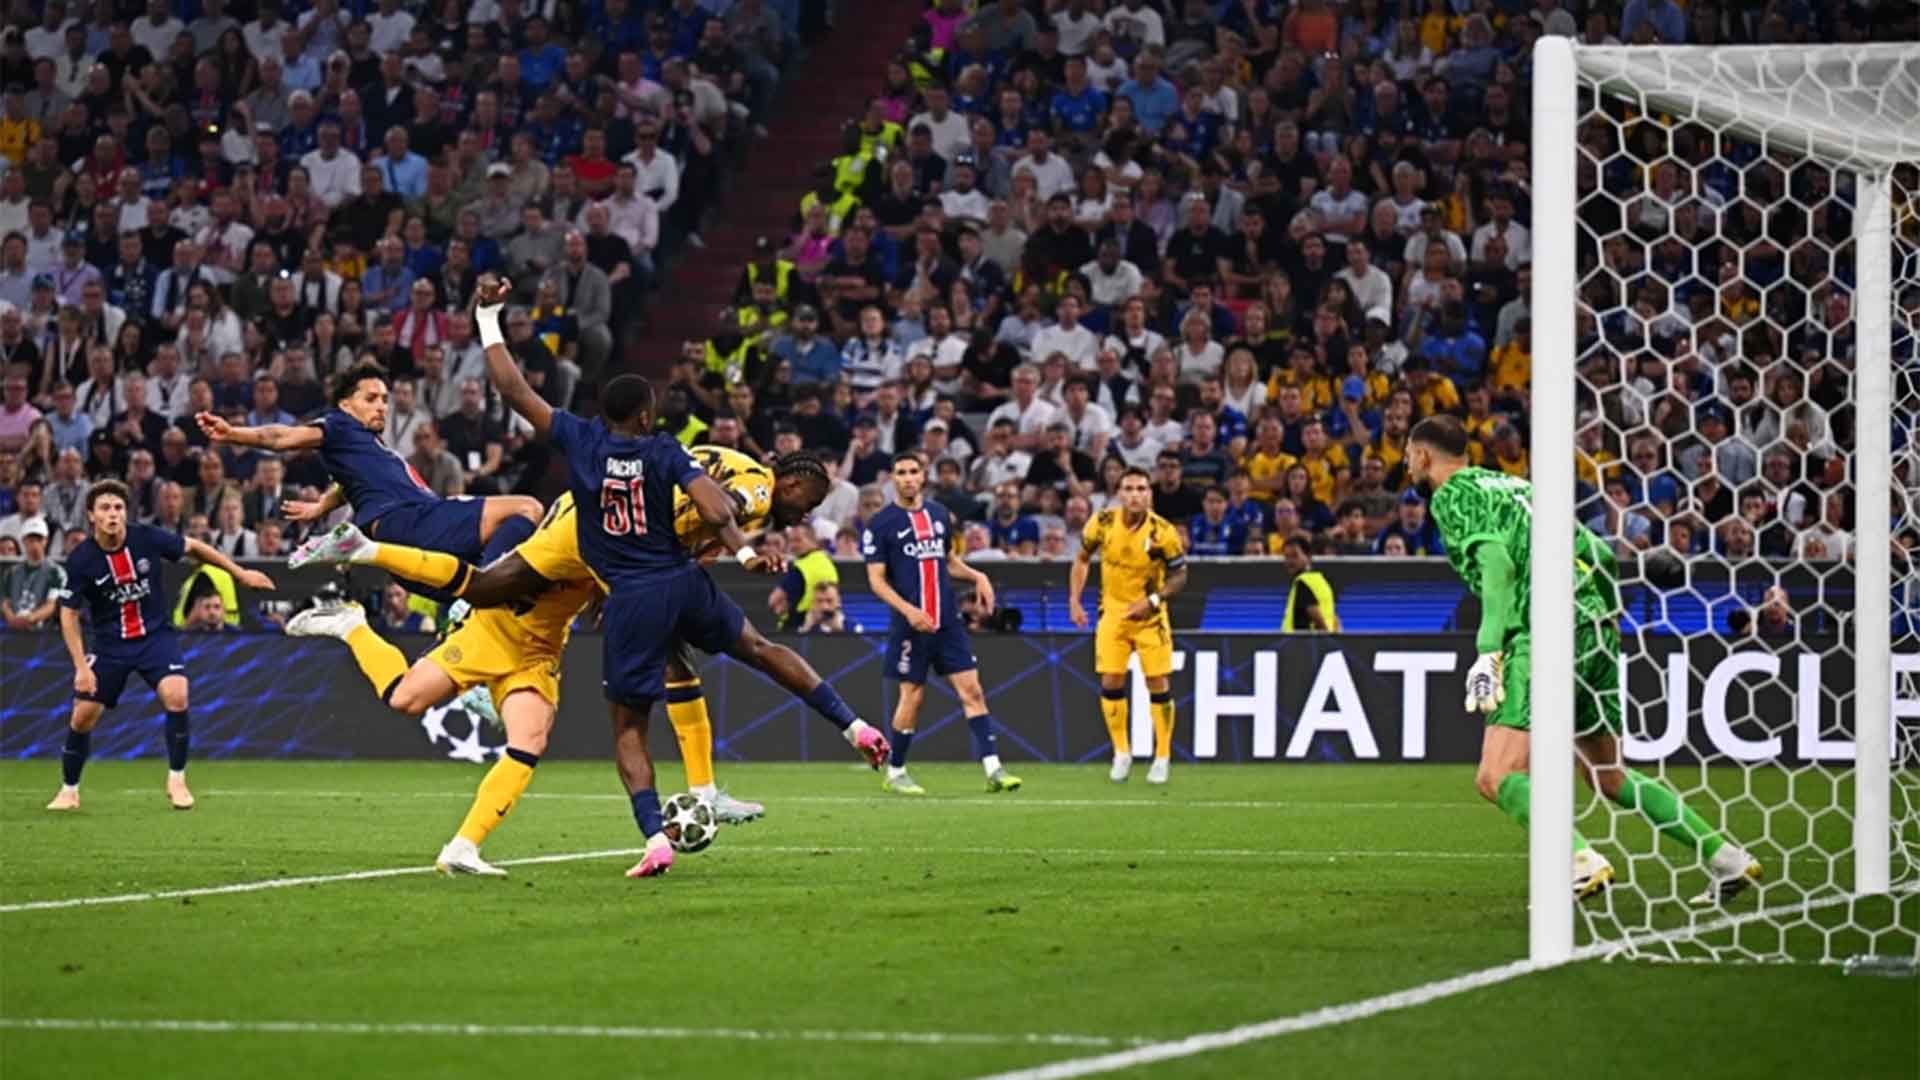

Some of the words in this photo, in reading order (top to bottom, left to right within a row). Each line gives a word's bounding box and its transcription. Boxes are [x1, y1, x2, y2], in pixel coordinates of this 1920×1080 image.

[606, 457, 643, 477] PACHO
[601, 476, 648, 536] 51
[1127, 651, 1457, 758] THAT
